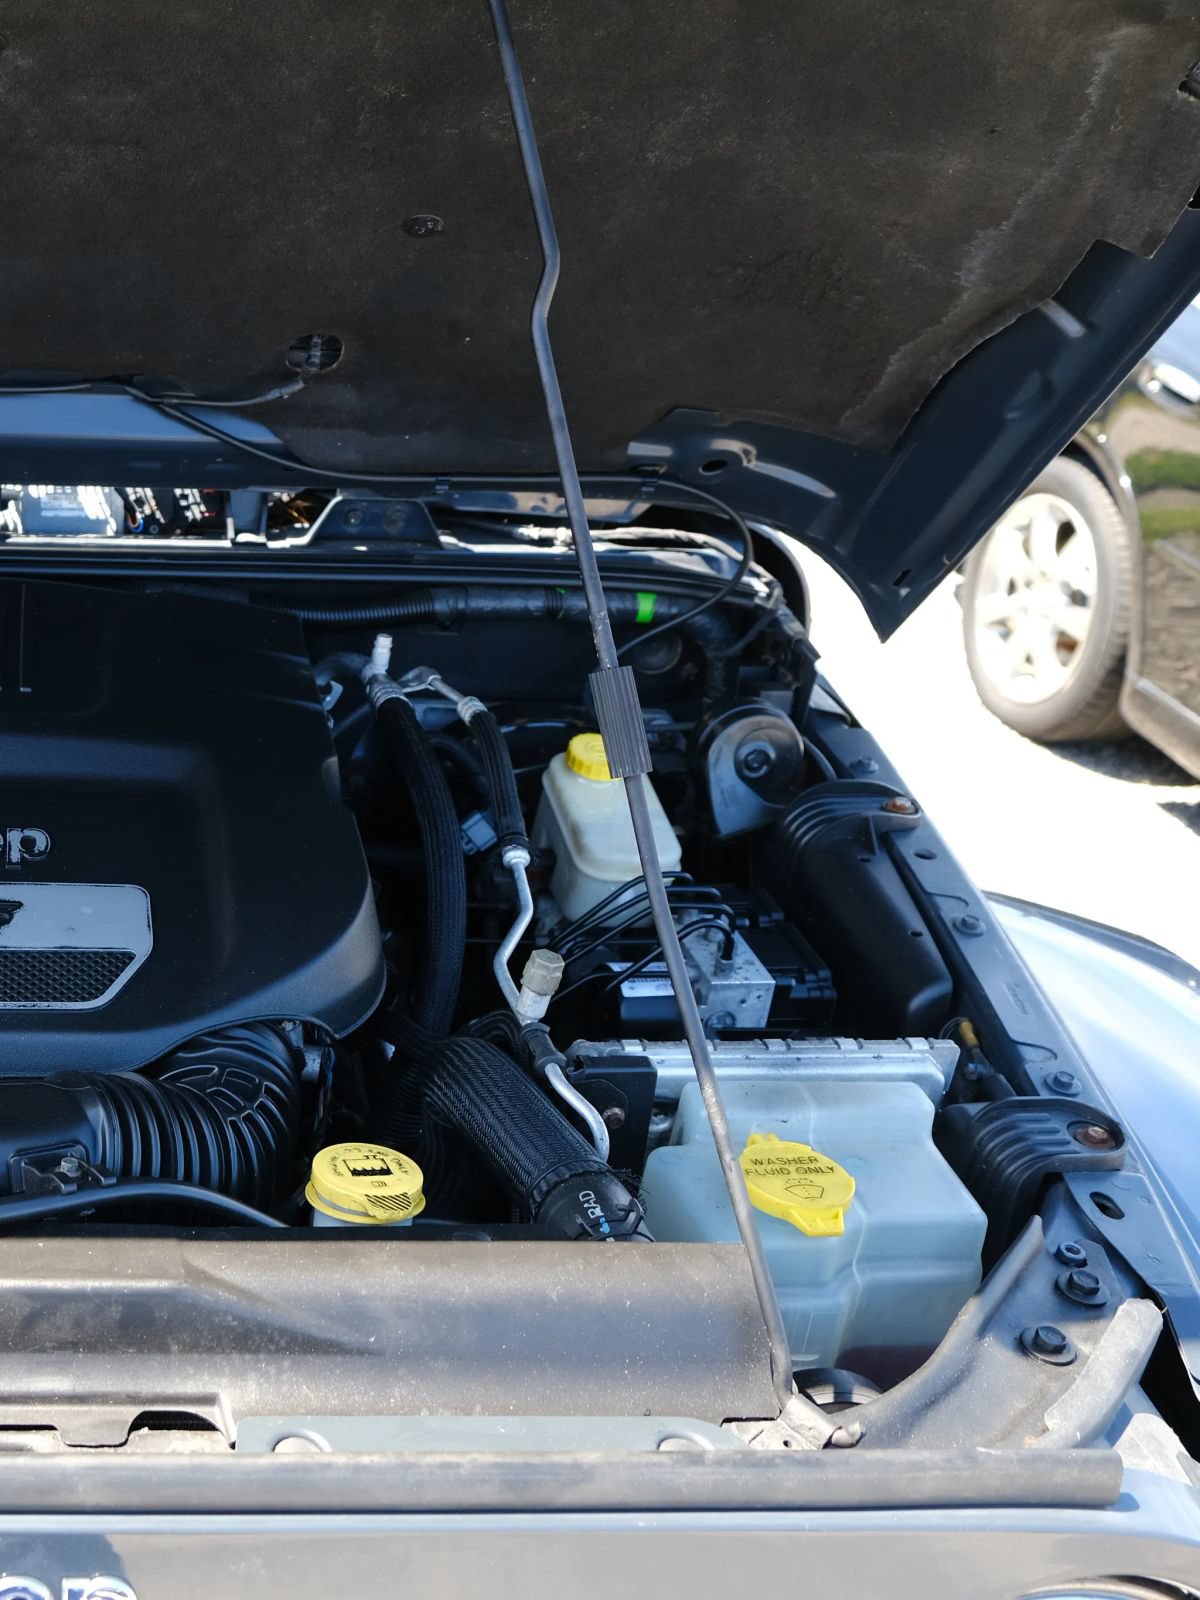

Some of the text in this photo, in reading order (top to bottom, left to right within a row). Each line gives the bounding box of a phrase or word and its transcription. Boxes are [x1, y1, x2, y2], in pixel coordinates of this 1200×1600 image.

[749, 1155, 820, 1166] WASHER
[744, 1165, 836, 1177] FLUID ONLY
